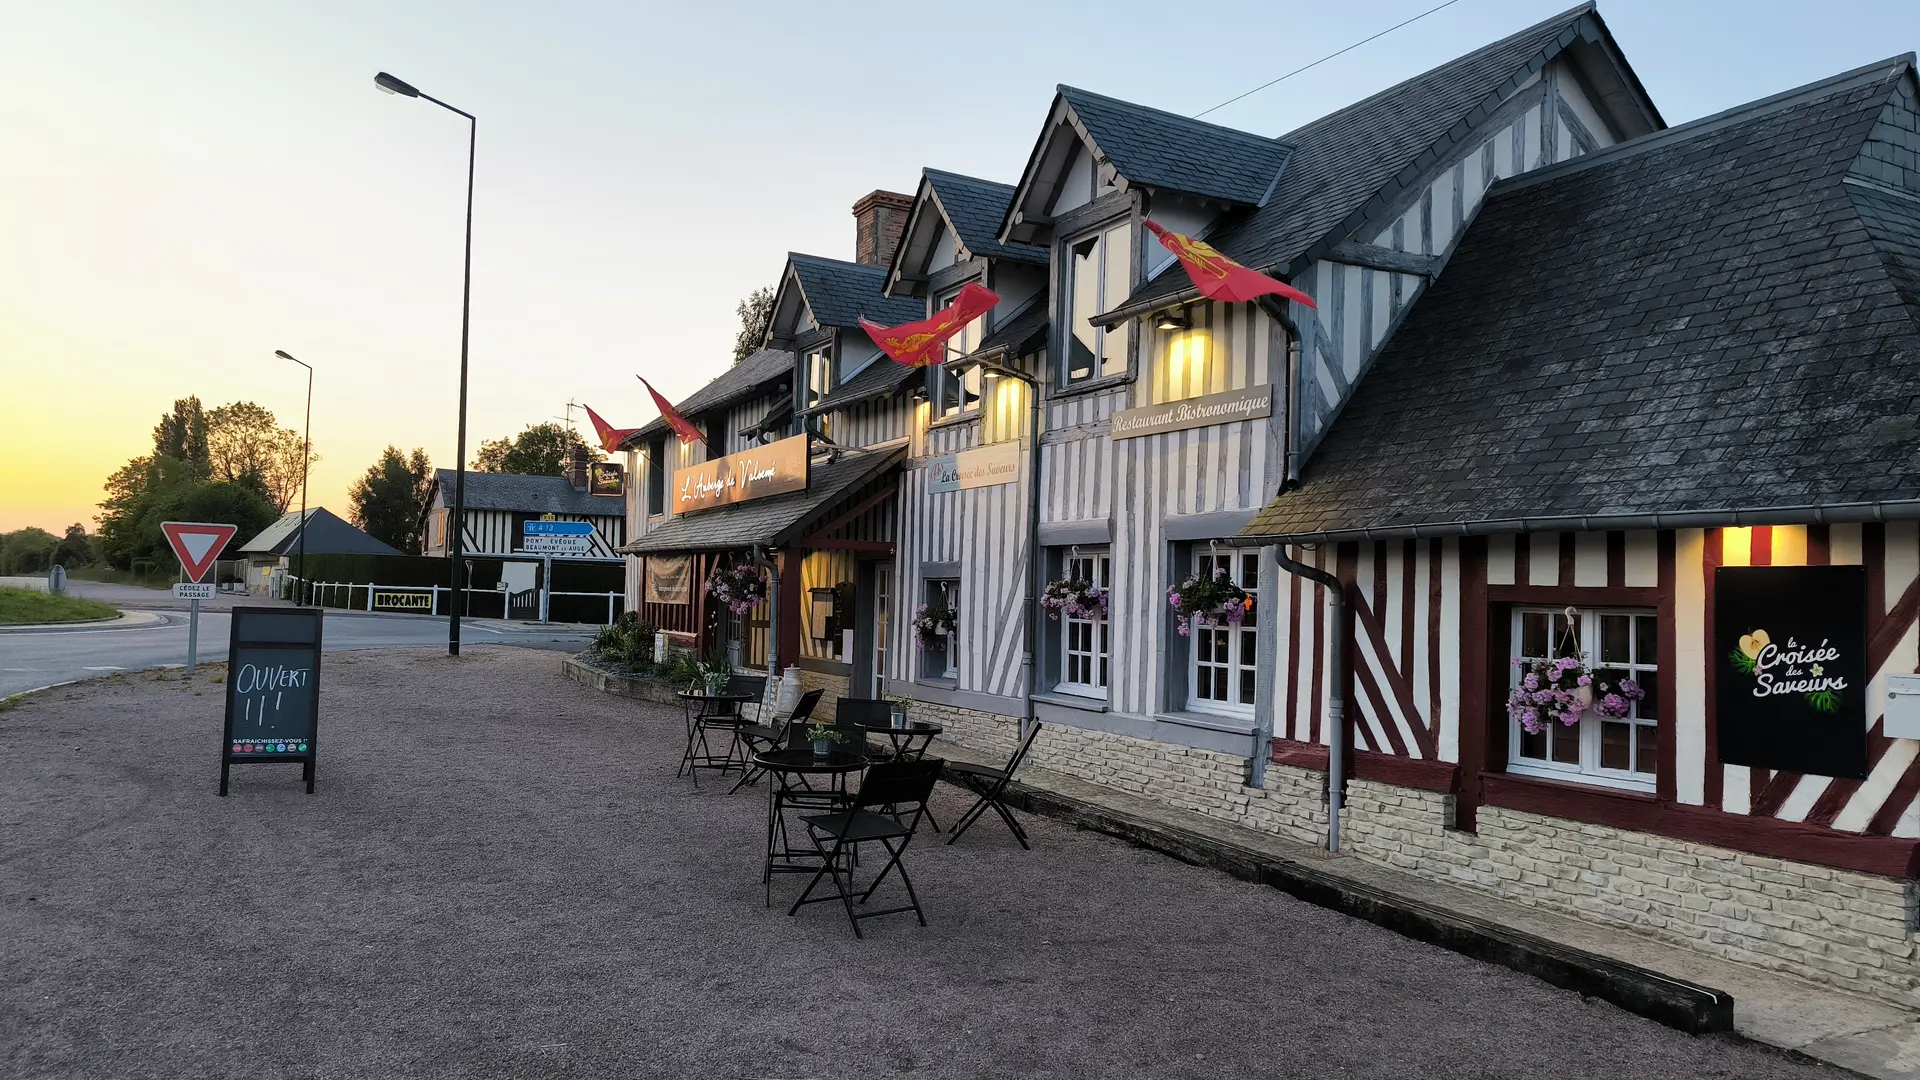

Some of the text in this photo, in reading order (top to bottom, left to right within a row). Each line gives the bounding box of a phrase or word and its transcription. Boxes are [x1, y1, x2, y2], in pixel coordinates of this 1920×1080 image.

[1112, 396, 1269, 433] Restaurant Bistronomique
[726, 467, 736, 488] de
[941, 470, 950, 484] La
[986, 462, 1016, 477] Saveurs
[377, 594, 430, 607] BROCANTE
[1787, 636, 1798, 648] la
[1757, 638, 1841, 670] Croisée
[236, 663, 311, 694] OUVERT
[1785, 664, 1804, 677] des
[1752, 673, 1849, 698] Saveurs
